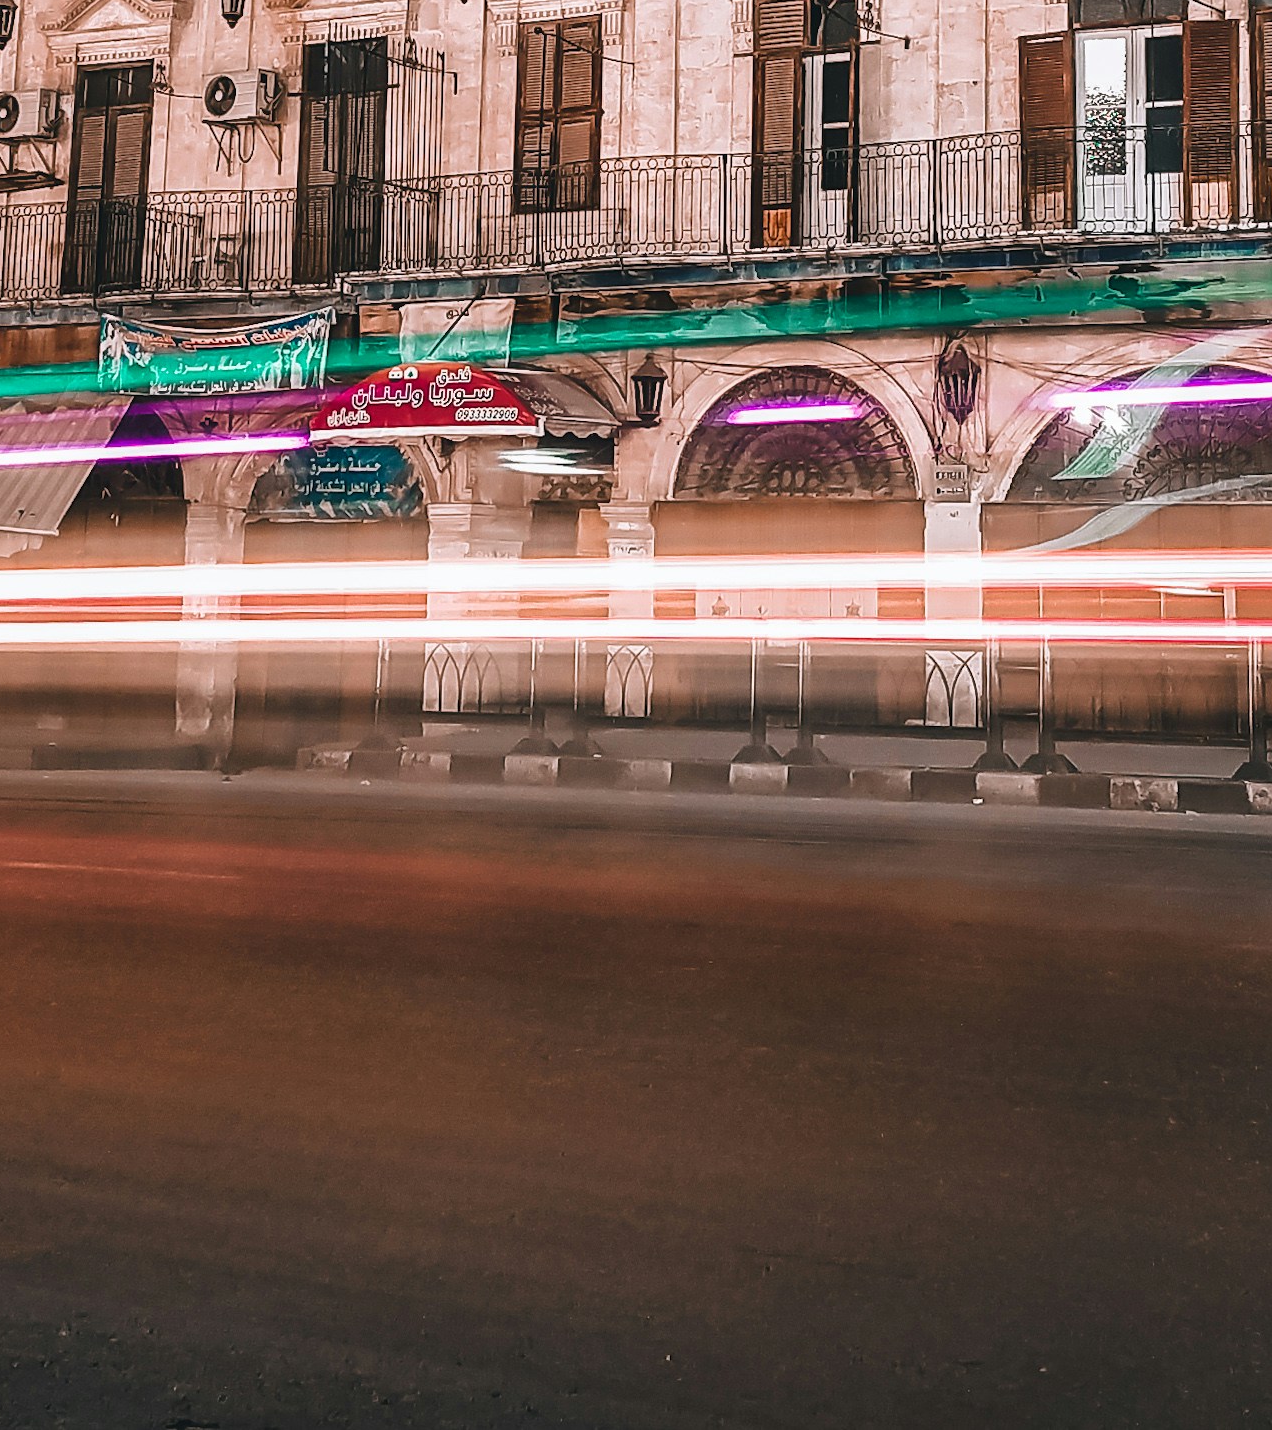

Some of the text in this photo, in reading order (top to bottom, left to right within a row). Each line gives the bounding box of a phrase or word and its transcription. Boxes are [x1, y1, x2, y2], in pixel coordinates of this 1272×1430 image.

[436, 366, 472, 386] فندق
[352, 383, 424, 410] ولبنان
[429, 382, 495, 407] سوريا
[326, 407, 371, 429] طابق أول
[455, 407, 519, 422] 0933332906
[309, 458, 340, 476] مفرق
[315, 478, 346, 496] تشكيلة
